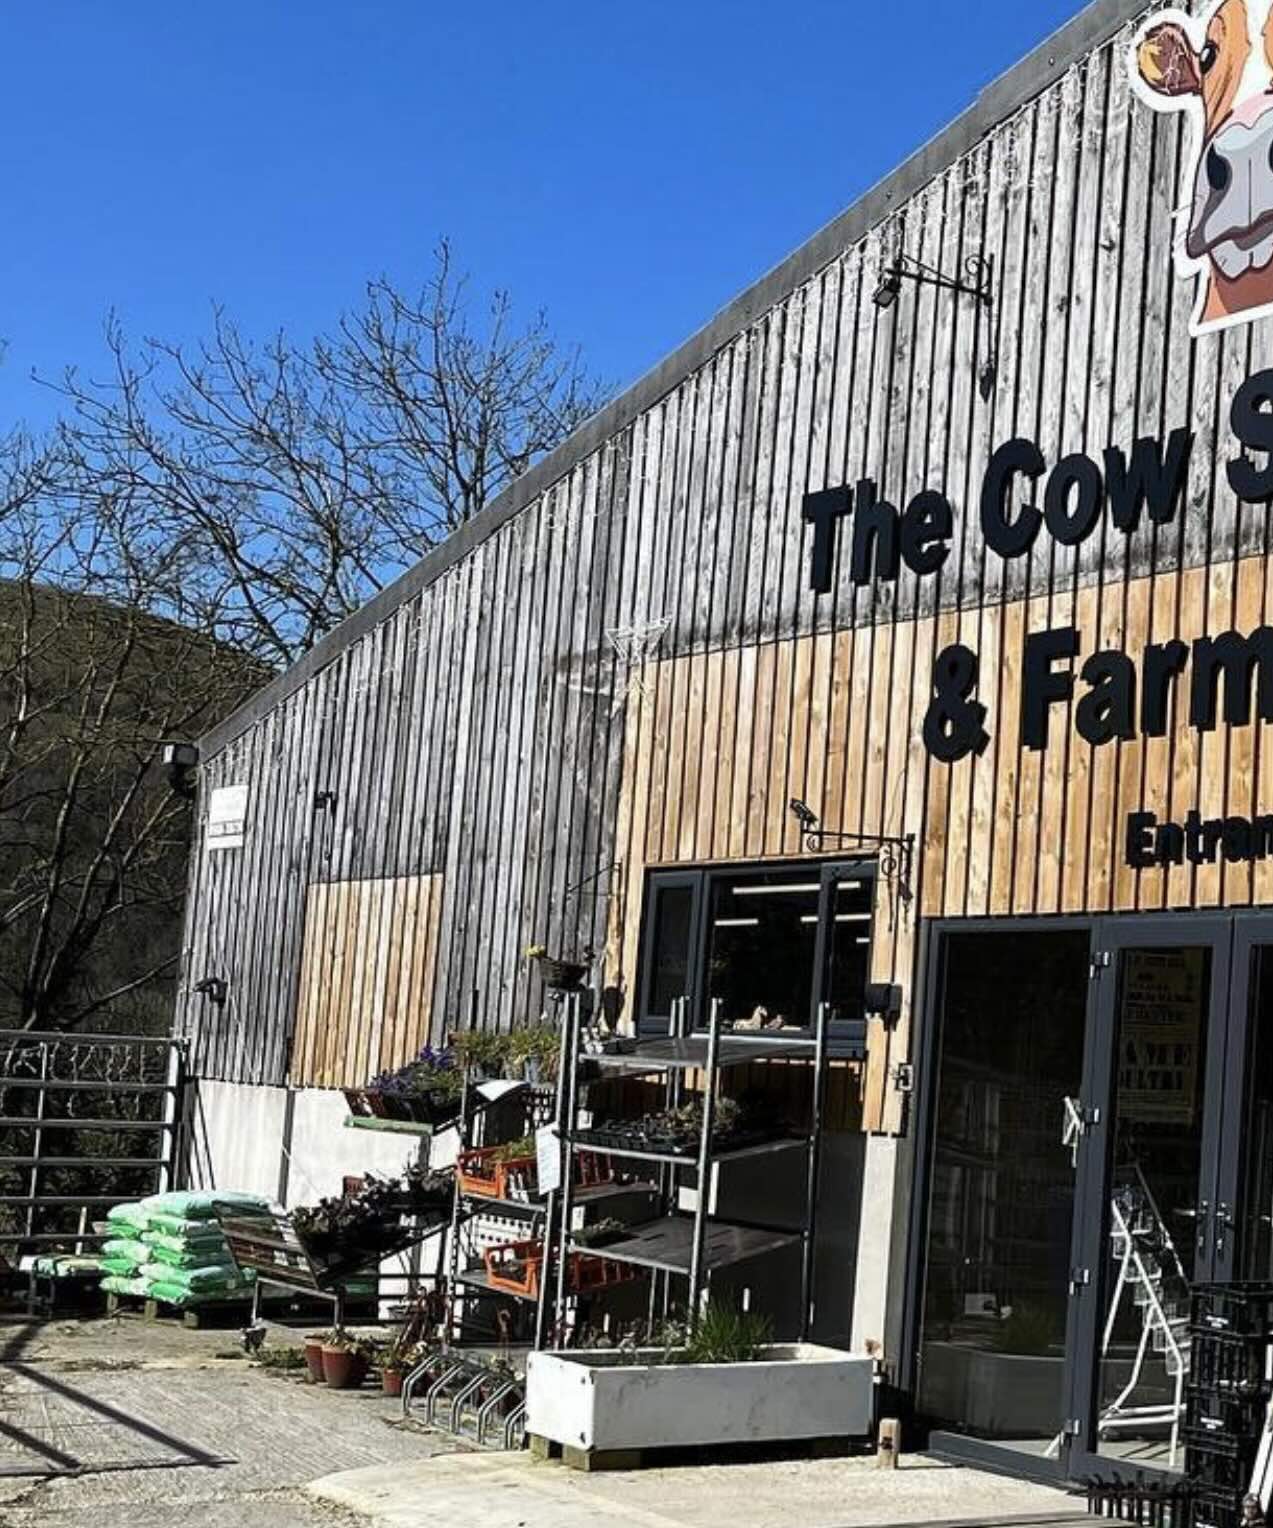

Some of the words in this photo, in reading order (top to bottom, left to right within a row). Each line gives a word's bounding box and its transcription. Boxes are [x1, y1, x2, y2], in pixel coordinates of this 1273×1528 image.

[802, 479, 954, 593] The
[979, 427, 1195, 558] Cow
[922, 643, 990, 763] &
